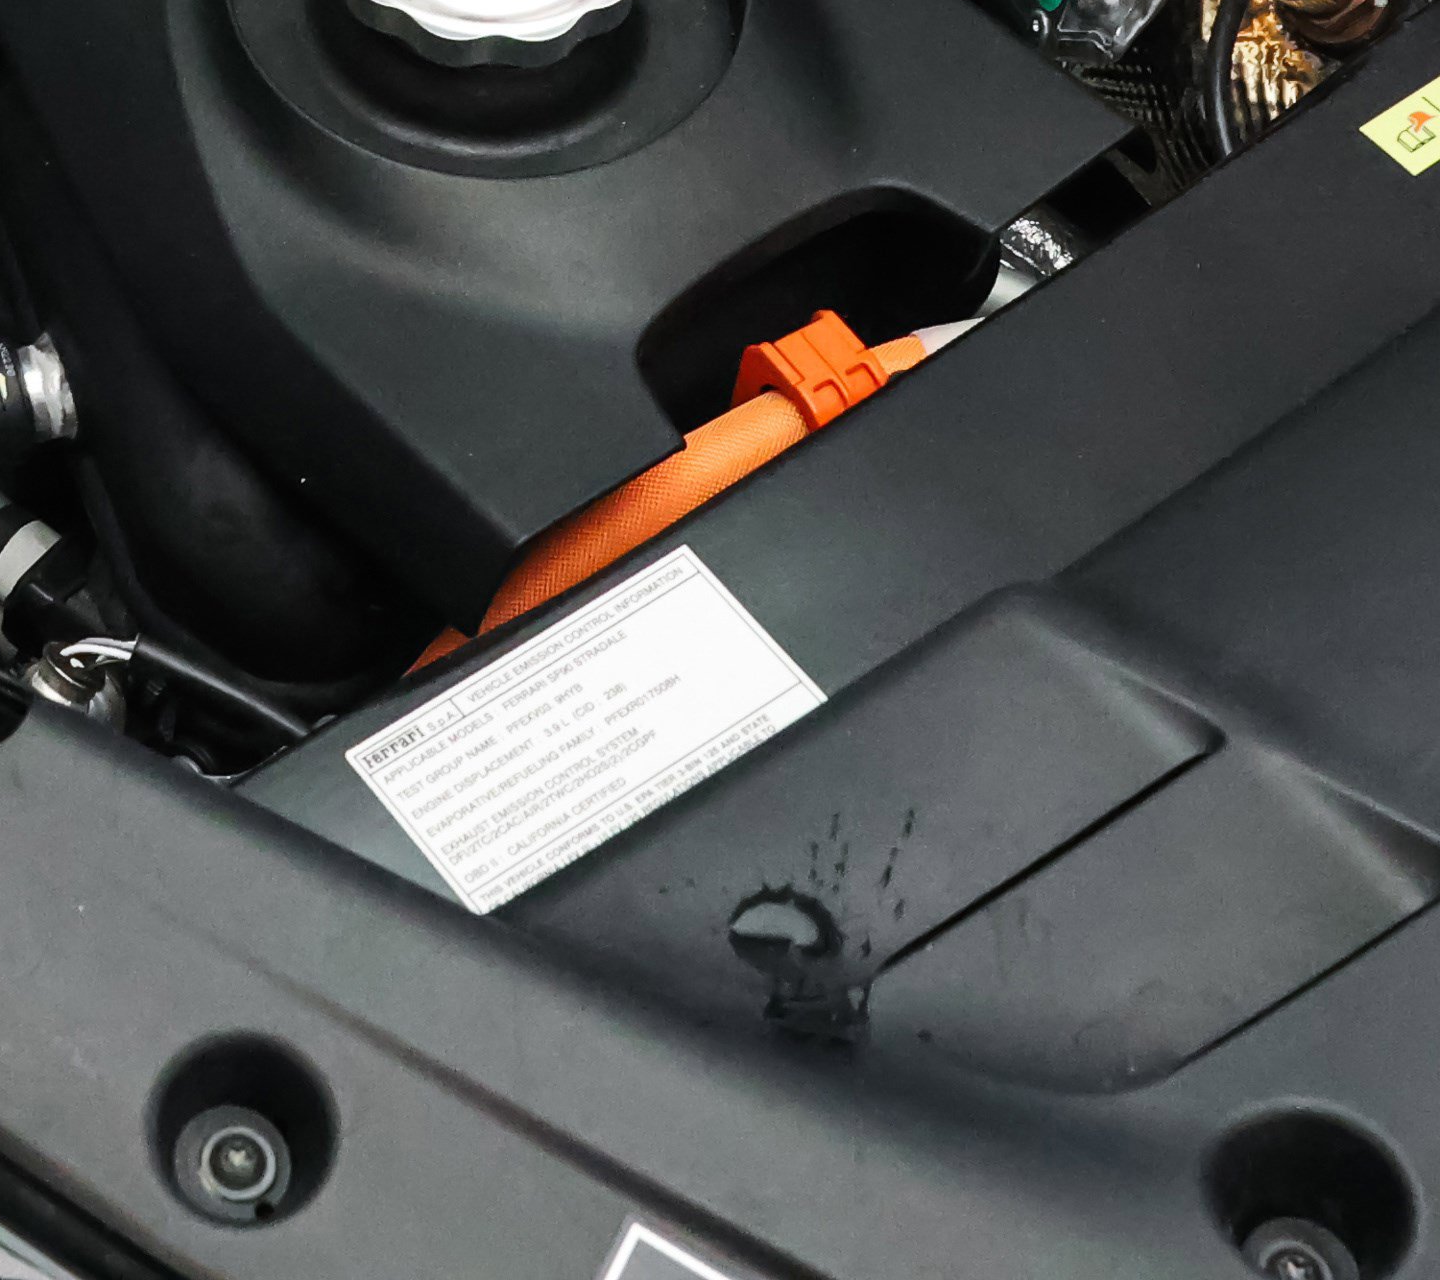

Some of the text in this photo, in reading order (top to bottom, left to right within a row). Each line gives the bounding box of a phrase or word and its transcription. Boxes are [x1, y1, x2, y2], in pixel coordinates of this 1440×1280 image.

[468, 567, 683, 702] VEHICLE EMISSION CONTROL INFORMATION
[361, 725, 425, 769] Ferrari
[383, 741, 446, 782] APPLICABLE
[448, 713, 493, 742] MODELS
[502, 681, 545, 709] FERRARI
[573, 631, 626, 665] STRADALE
[397, 781, 424, 800] TEST
[425, 757, 464, 783] GROUP
[465, 737, 497, 758] NAME
[412, 790, 452, 817] ENGINE
[453, 739, 535, 792] DISPLACEMENT
[426, 751, 558, 835] EVAPORATIVE/REFUELING
[559, 728, 596, 752] FAMILY
[441, 728, 638, 853] EXHAUST EMISSION CONTROL SYSTEM
[480, 885, 502, 900] THIS
[504, 859, 543, 885] VEHICLE
[545, 824, 599, 859] CONFORMS
[600, 814, 615, 825] TO
[634, 789, 653, 803] EPA
[655, 775, 675, 789] TIER
[720, 734, 740, 747] AND
[741, 714, 769, 733] STATE
[464, 864, 489, 882] OBD
[506, 813, 570, 855] CALIFORNIA
[571, 777, 626, 814] CERTIFIED
